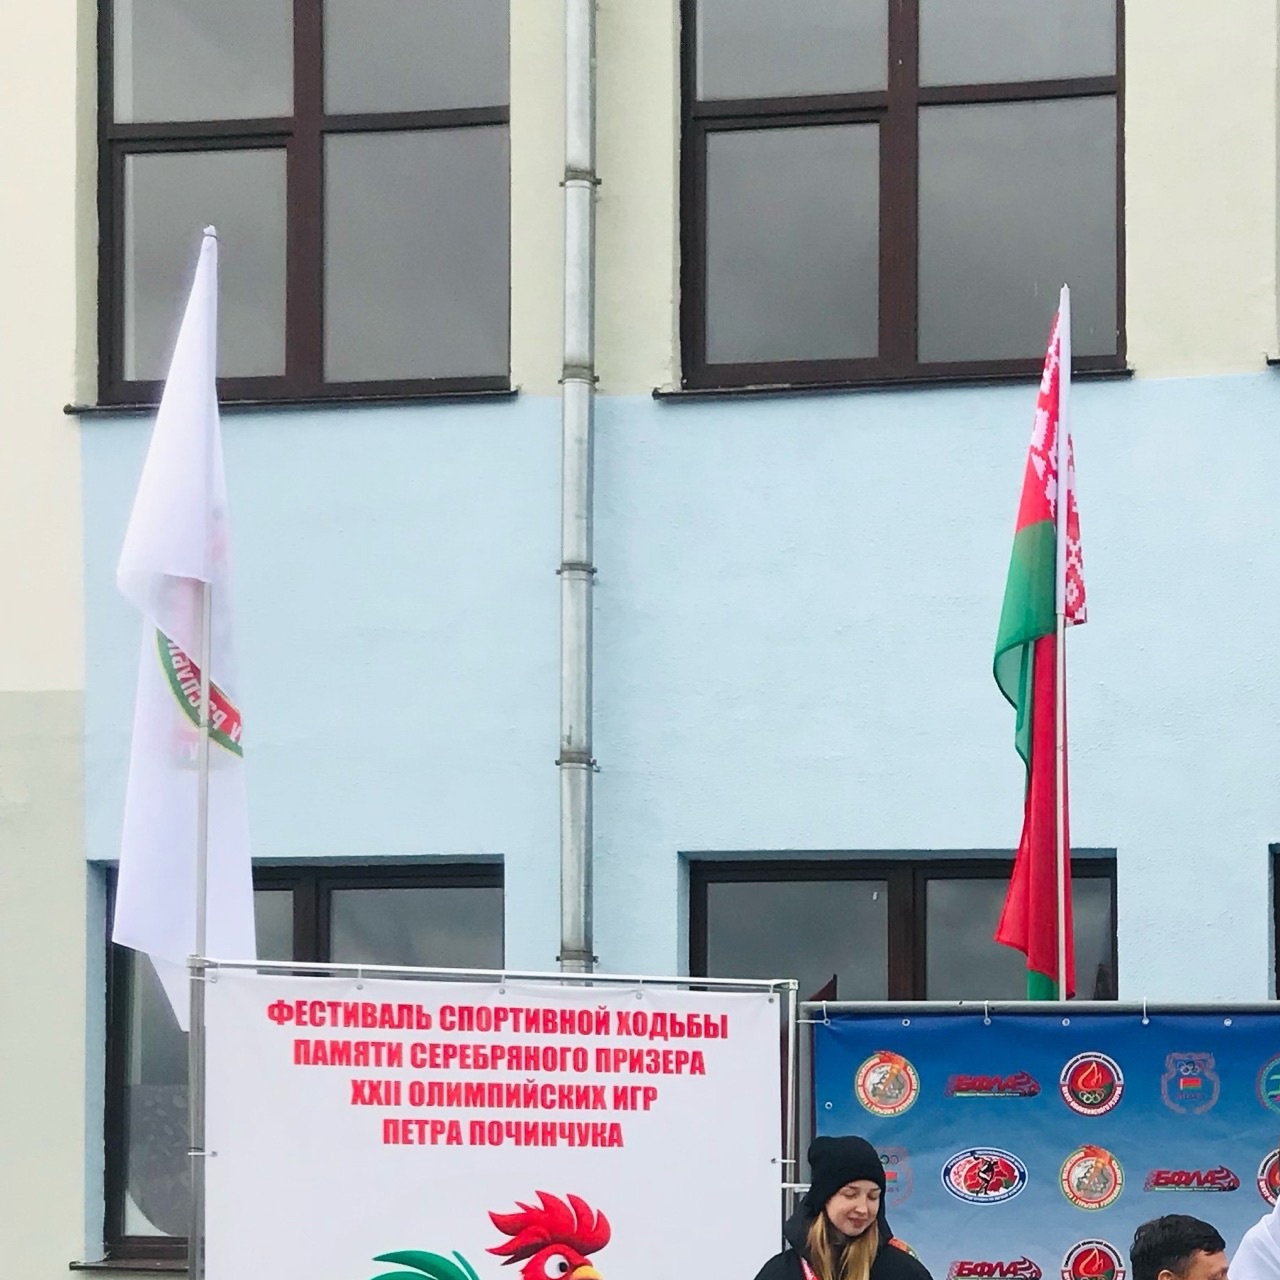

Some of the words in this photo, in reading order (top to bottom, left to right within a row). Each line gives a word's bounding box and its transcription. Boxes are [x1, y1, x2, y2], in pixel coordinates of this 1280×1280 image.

[266, 999, 432, 1030] ФЕСТИВАЛЬ
[438, 1003, 610, 1036] СПОРТИВНОЙ
[616, 1010, 729, 1040] ХОДЬБЫ
[293, 1039, 403, 1068] ПАМЯТИ
[410, 1042, 589, 1073] СЕРЕБРЯНОГО
[595, 1047, 706, 1076] ПРИЗЕРА
[350, 1078, 402, 1107] XXII
[407, 1078, 607, 1110] ОЛИМПИЙСКИХ
[612, 1084, 658, 1111] ИГР
[382, 1118, 463, 1146] ПЕТРА
[468, 1120, 624, 1148] ПОЧИНЧУКА
[956, 1260, 1019, 1278] БФЛА
